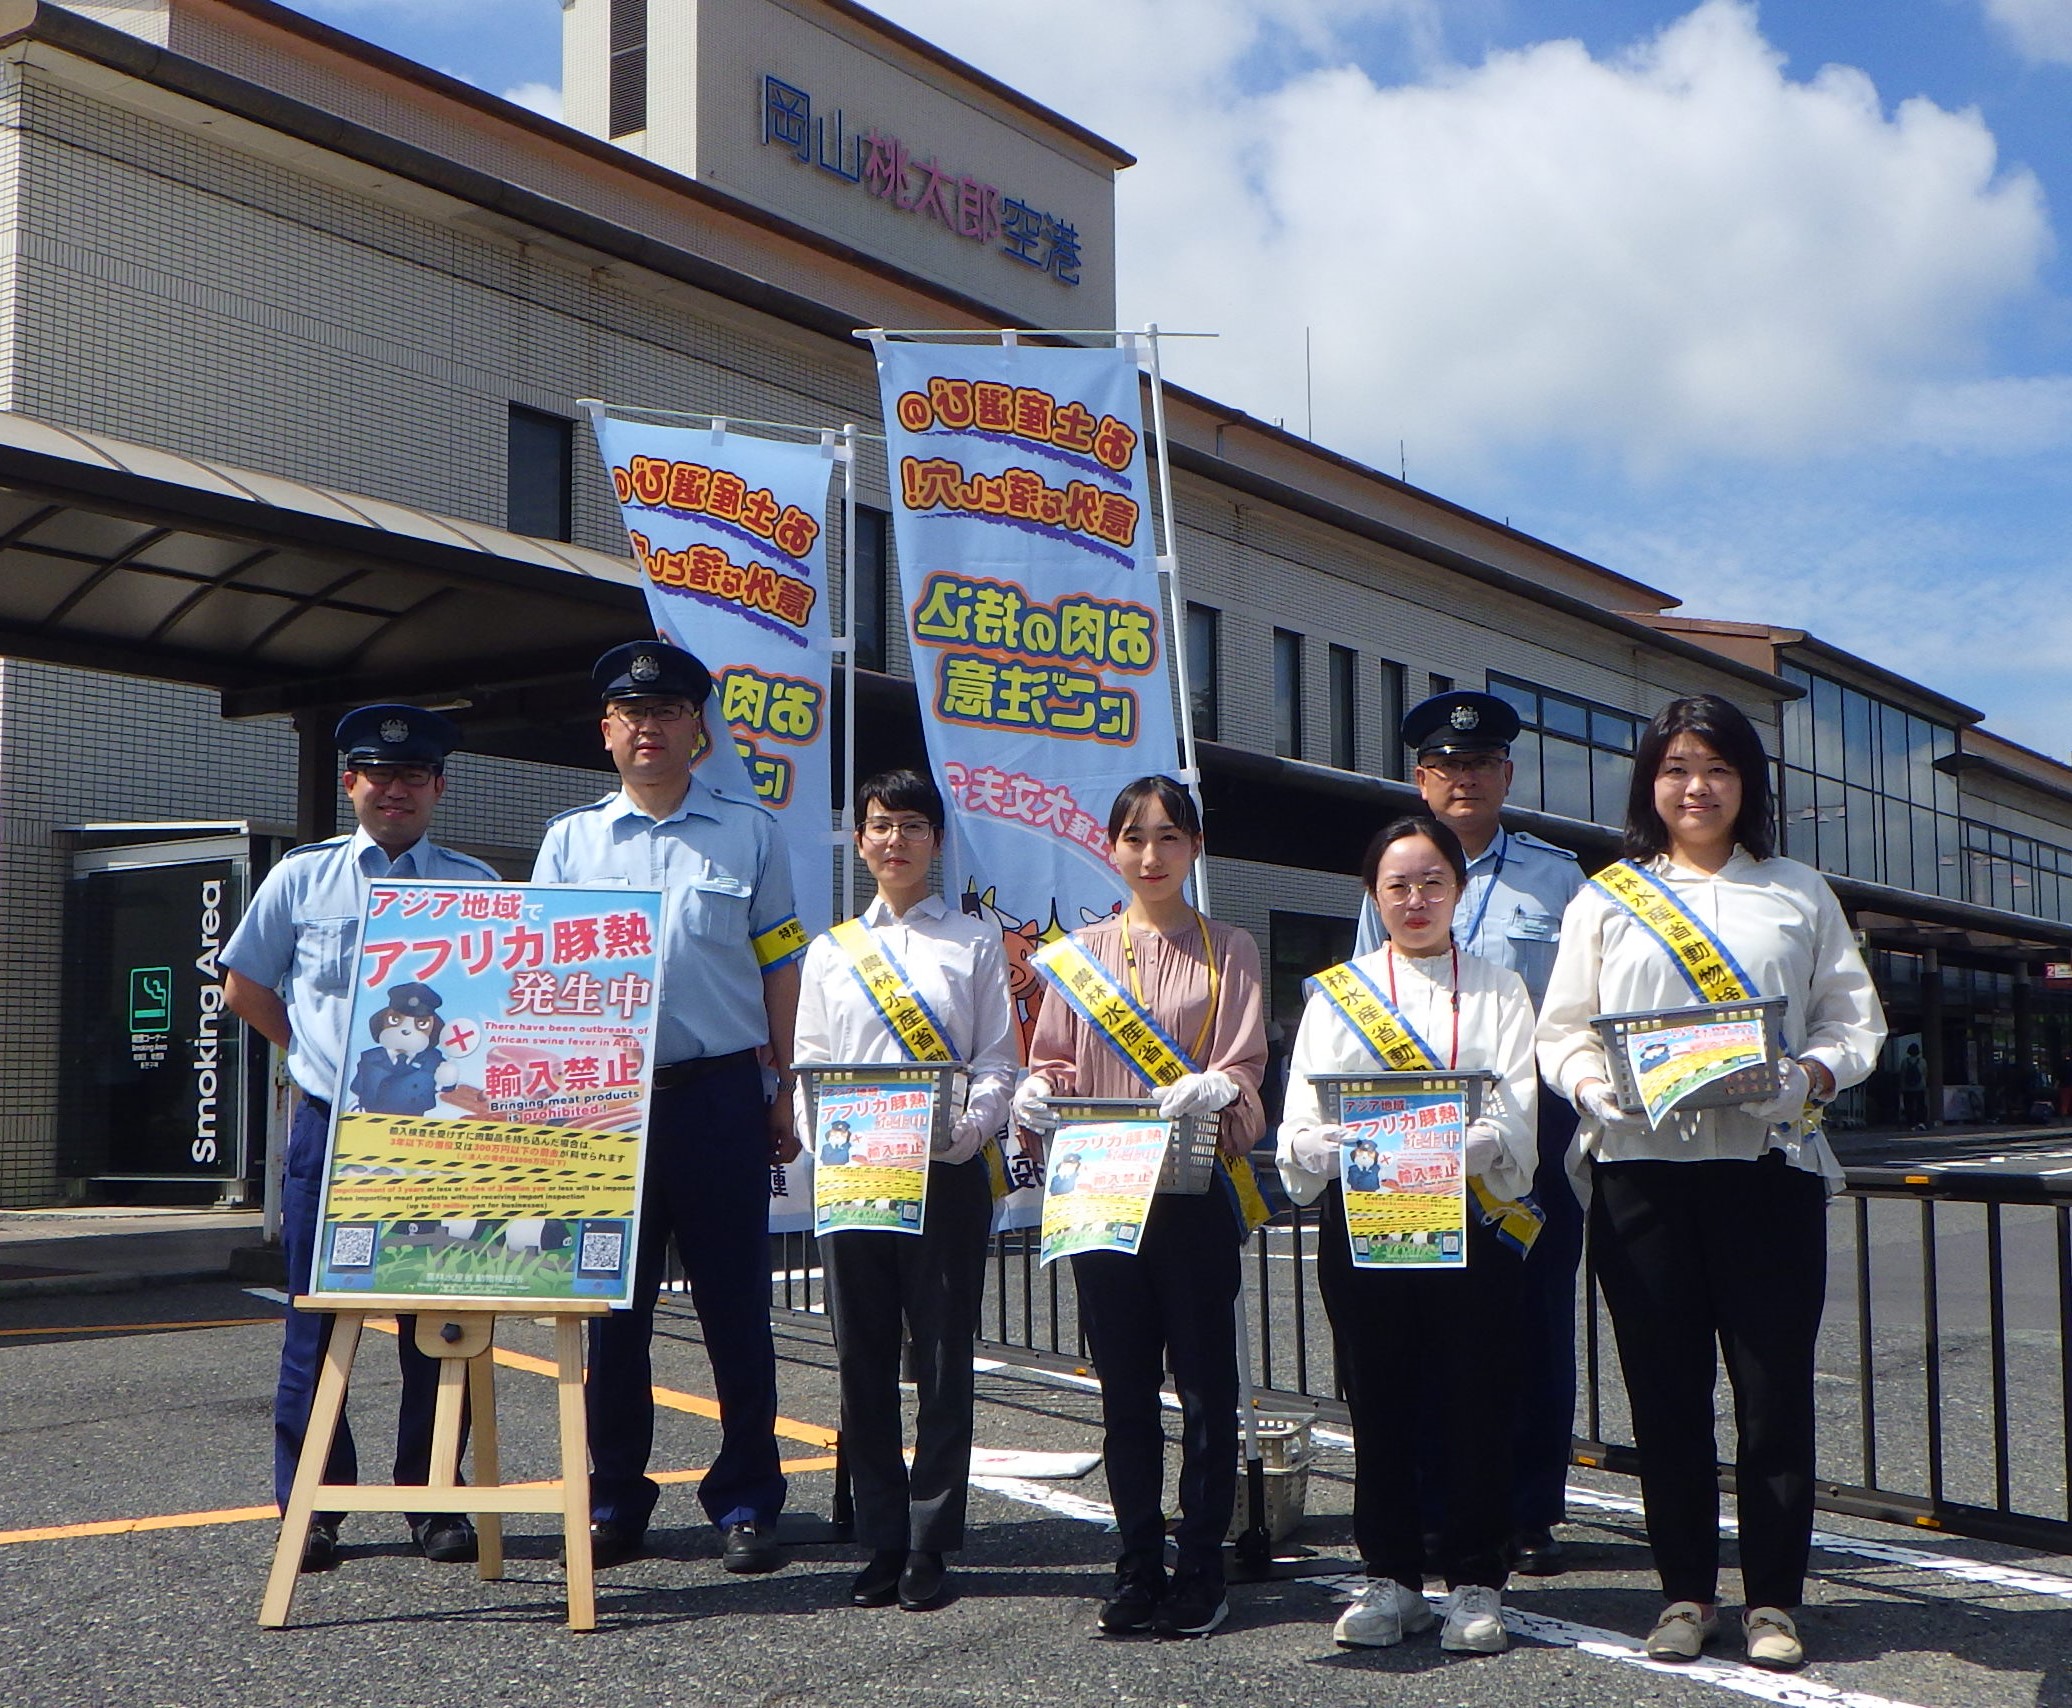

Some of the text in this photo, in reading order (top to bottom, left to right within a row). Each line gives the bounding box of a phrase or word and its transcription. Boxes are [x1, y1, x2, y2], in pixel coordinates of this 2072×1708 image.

[762, 74, 1080, 286] 岡山桃太郎空港
[371, 890, 545, 921] アジア地域で
[363, 911, 653, 988] アフリカ豚熱
[506, 969, 652, 1020] 発生中
[192, 879, 225, 1164] Smoking Area
[485, 1022, 649, 1035] There have been outbreaks of
[489, 1035, 529, 1044] African
[533, 1036, 564, 1045] swine
[568, 1037, 597, 1046] fever
[600, 1038, 609, 1047] in
[1325, 970, 1428, 1071] 林水産省動
[485, 1053, 640, 1100] 輸入禁止
[490, 1090, 640, 1112] Bringing meat products
[508, 1112, 519, 1122] is
[523, 1105, 599, 1121] prohibited
